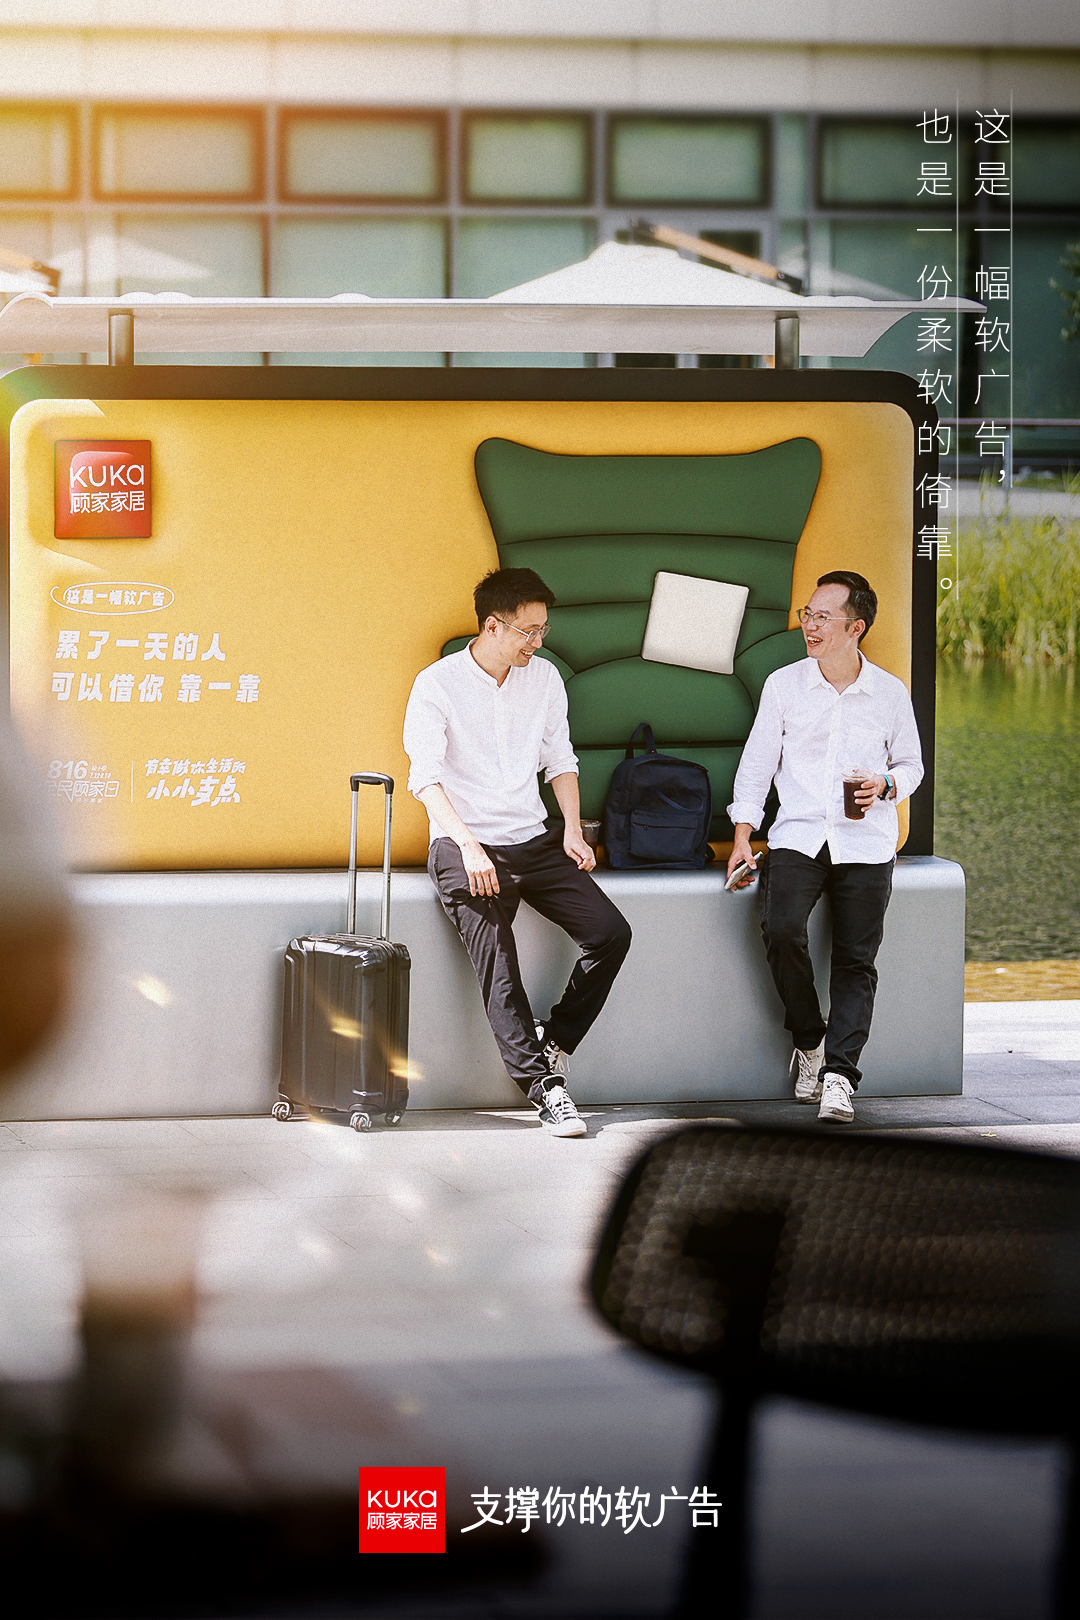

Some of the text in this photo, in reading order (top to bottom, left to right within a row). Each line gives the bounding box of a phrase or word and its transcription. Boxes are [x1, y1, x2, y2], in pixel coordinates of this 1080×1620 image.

[69, 490, 145, 514] 顾家家居
[66, 588, 165, 607] 这是一幅软广告
[55, 630, 227, 661] 累了一天的人
[51, 672, 262, 703] 可以借你 靠一靠
[47, 759, 89, 779] 816
[146, 774, 241, 807] 小小支点
